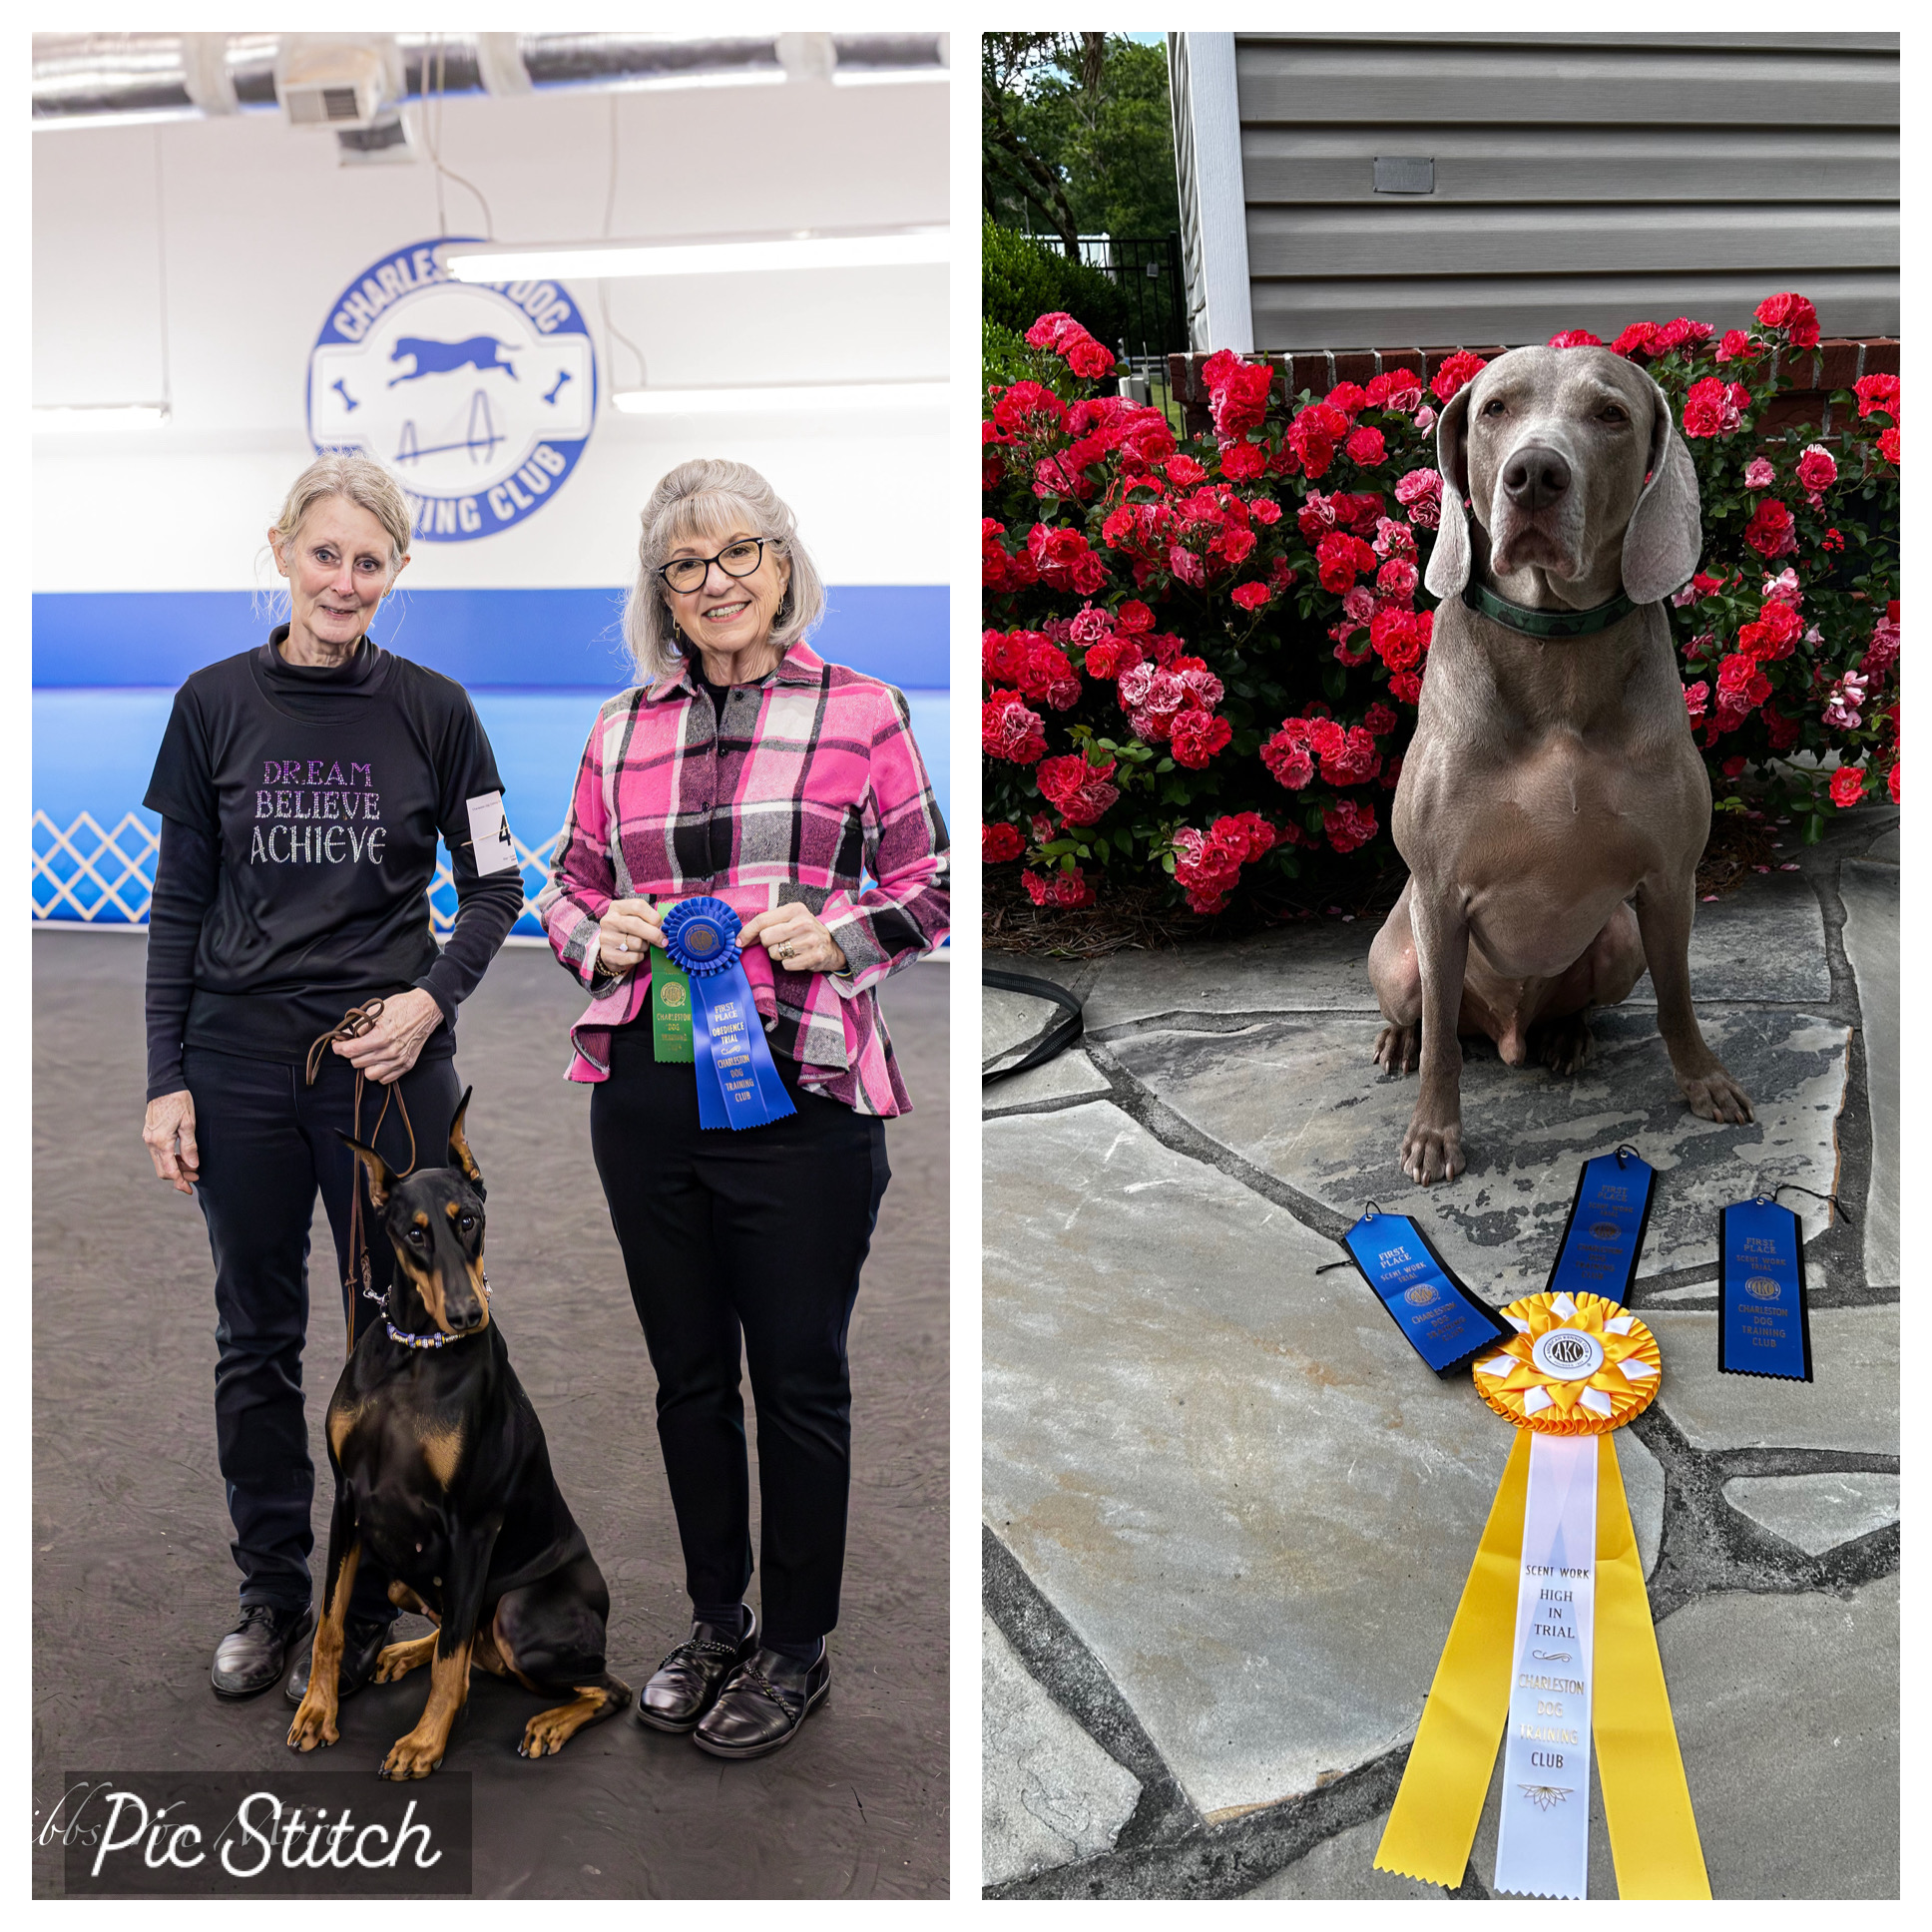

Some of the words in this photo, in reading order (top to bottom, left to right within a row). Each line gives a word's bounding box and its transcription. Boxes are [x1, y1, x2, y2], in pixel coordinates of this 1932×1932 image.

[487, 445, 566, 521] CLUB
[262, 760, 373, 787] DREAM
[254, 789, 380, 820] BELIEVE
[499, 813, 511, 846] 4
[251, 824, 387, 865] ACHIEVE
[715, 1002, 734, 1014] FIRST
[715, 1010, 738, 1023] PLACE
[713, 1021, 745, 1037] OBEDIENCE
[722, 1034, 738, 1045] TRIAL
[717, 1054, 750, 1069] CHARLESTON
[730, 1068, 744, 1078] DOG
[725, 1079, 754, 1092] TRAINING
[734, 1091, 751, 1103] CLUB
[1743, 1243, 1777, 1254] PLACE
[1745, 1237, 1775, 1247] FIRST
[1378, 1246, 1405, 1261] FIRST
[1380, 1253, 1412, 1269] PLACE
[1736, 1254, 1758, 1263] SCENT
[1761, 1256, 1786, 1266] WORK
[1380, 1269, 1402, 1282] SCENT
[1404, 1261, 1427, 1274] WORK
[1750, 1262, 1772, 1271] TRIAL
[1398, 1272, 1418, 1284] TRIAL
[1411, 1301, 1458, 1325] CHARLESTON
[1737, 1303, 1788, 1317] CHARLESTON
[1431, 1314, 1451, 1328] DOG
[1753, 1315, 1773, 1326] DOG
[1741, 1325, 1786, 1338] TRAINING
[1752, 1337, 1776, 1348] CLUB
[1554, 1340, 1583, 1362] AKC
[1525, 1564, 1555, 1577] SCENT
[1560, 1567, 1590, 1580] WORK
[1540, 1588, 1574, 1603] HIGH
[1548, 1608, 1563, 1620] IN
[1534, 1623, 1576, 1639] TRIAL
[1518, 1673, 1585, 1695] CHARLESTON
[1537, 1699, 1564, 1717] DOG
[1519, 1722, 1579, 1745] TRAINING
[1531, 1751, 1564, 1768] CLUB
